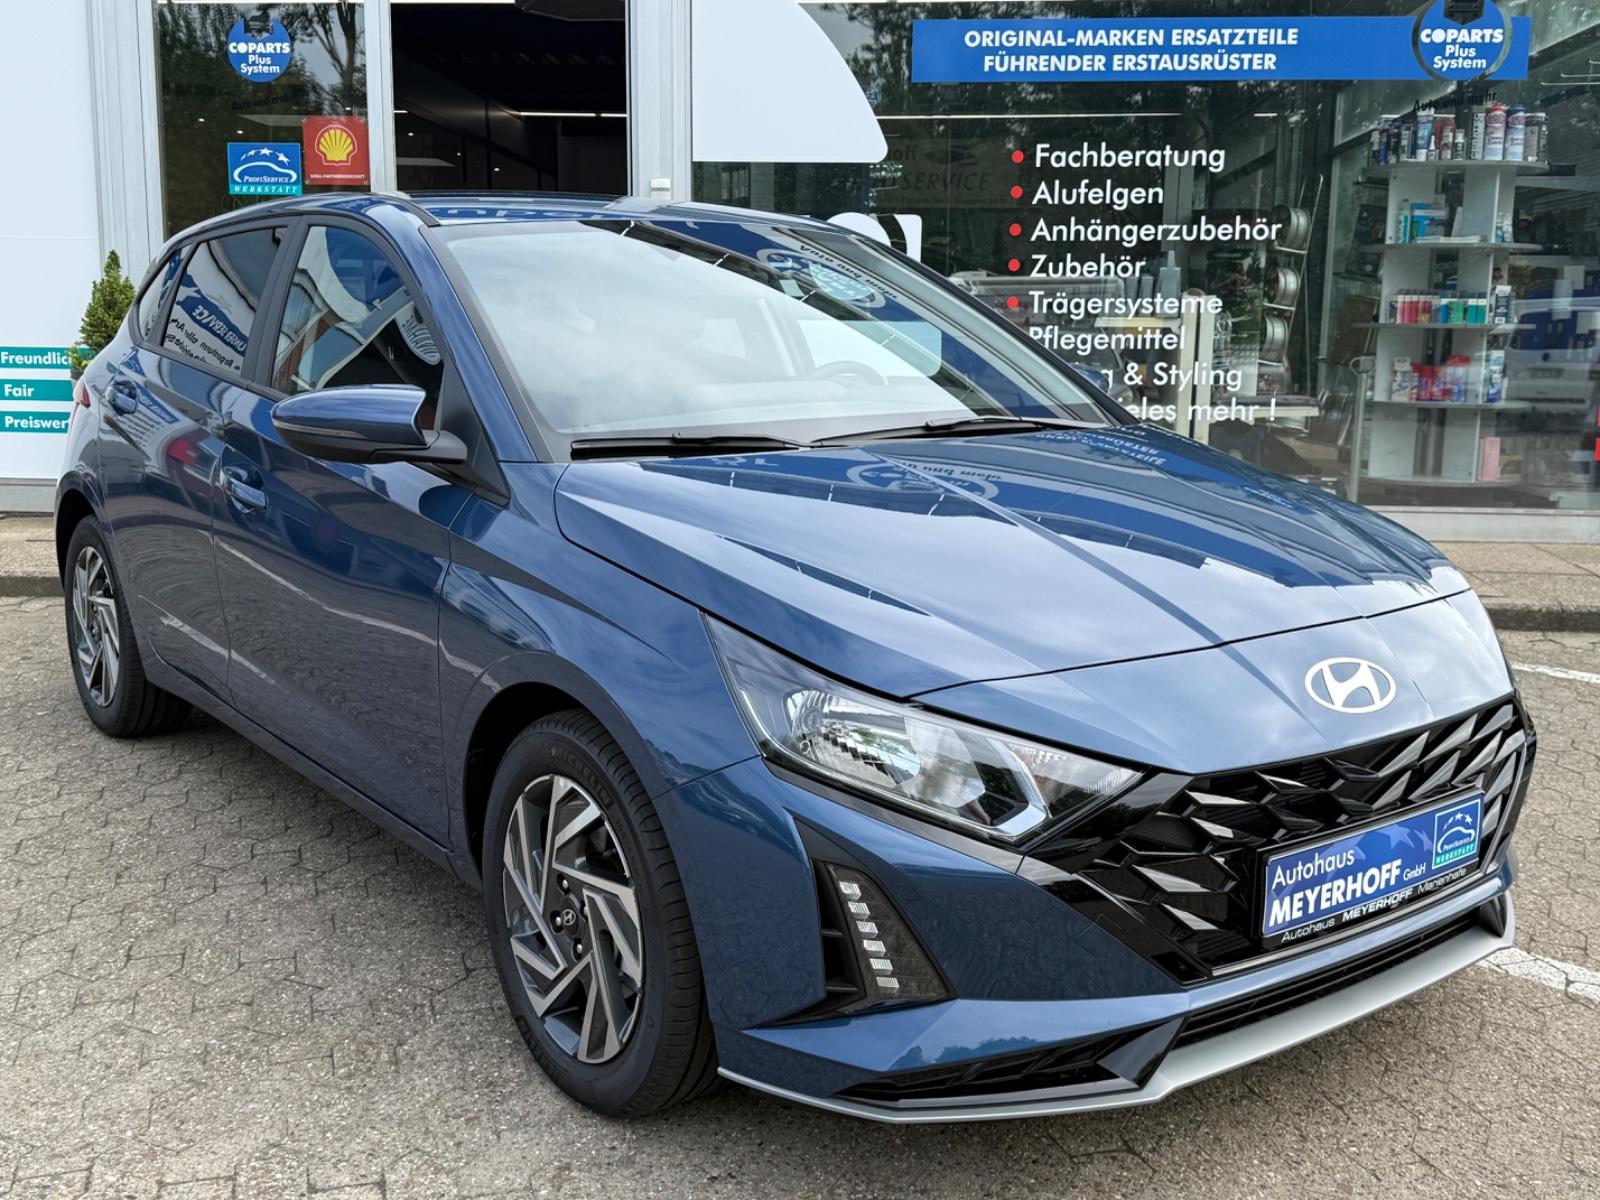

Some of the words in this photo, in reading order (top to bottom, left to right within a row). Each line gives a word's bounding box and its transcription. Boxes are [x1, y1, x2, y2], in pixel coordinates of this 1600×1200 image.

[229, 42, 290, 53] COPARTS
[964, 29, 1164, 47] ORIGINAL-MARKEN
[1171, 28, 1299, 45] ERSATZTEILE
[1420, 28, 1504, 43] COPARTS
[248, 54, 271, 64] Plus
[984, 50, 1106, 72] FÜHRENDER
[1112, 49, 1277, 71] ERSTAUSRÜSTER
[1445, 45, 1476, 57] Plus
[240, 63, 280, 75] System
[1433, 56, 1487, 71] System
[1035, 142, 1226, 172] Fachberatung
[234, 185, 298, 193] WERKSTATT
[1032, 179, 1164, 210] Alufelgen
[1030, 215, 1283, 246] Anhängerzubehör
[1029, 254, 1146, 279] Zubehör
[1028, 290, 1224, 319] Trägersysteme
[1029, 326, 1186, 356] Pflegemittel
[1123, 362, 1143, 386] &
[1153, 361, 1243, 392] Styling
[4, 384, 35, 397] Fair
[1117, 397, 1177, 421] eles
[1187, 397, 1259, 421] mehr
[1269, 398, 1277, 422] !
[4, 415, 69, 429] Preiswer
[1271, 849, 1355, 890] Autohaus
[1268, 859, 1403, 927] MEYERHOFF
[1403, 863, 1427, 881] GmbH
[1281, 917, 1336, 943] Autohaus
[1342, 888, 1413, 922] MEYERHOFF
